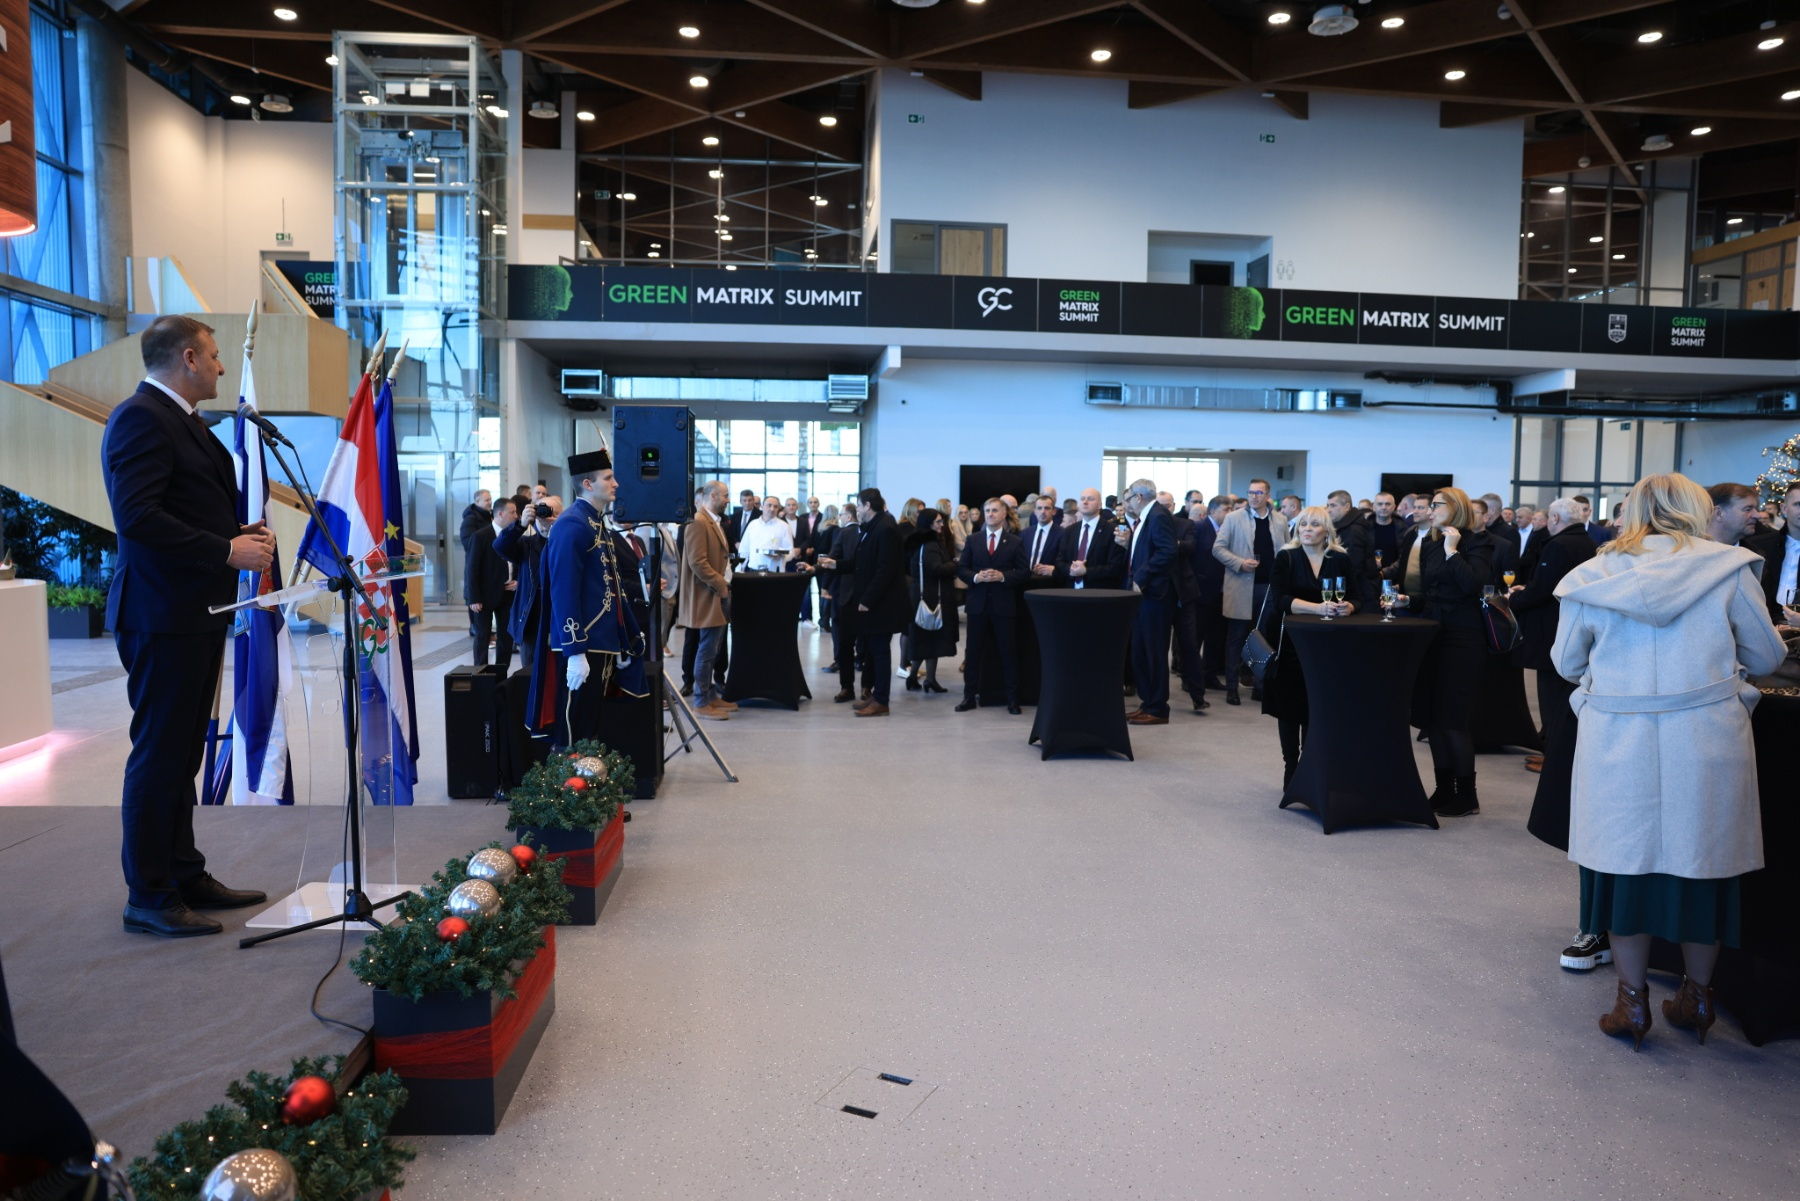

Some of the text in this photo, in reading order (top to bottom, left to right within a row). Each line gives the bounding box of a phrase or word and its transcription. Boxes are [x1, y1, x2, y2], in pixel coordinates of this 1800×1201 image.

[608, 284, 863, 307] GREEN MATRIX SUMMIT
[1059, 289, 1100, 301] GREEN
[1059, 301, 1099, 312] MATRIX
[1059, 312, 1099, 322] SUMMIT
[1286, 306, 1505, 332] GREEN MATRIX SUMMIT
[1672, 316, 1707, 327] GREEN
[1671, 327, 1706, 337] MATRIX
[1671, 337, 1706, 347] SUMMIT
